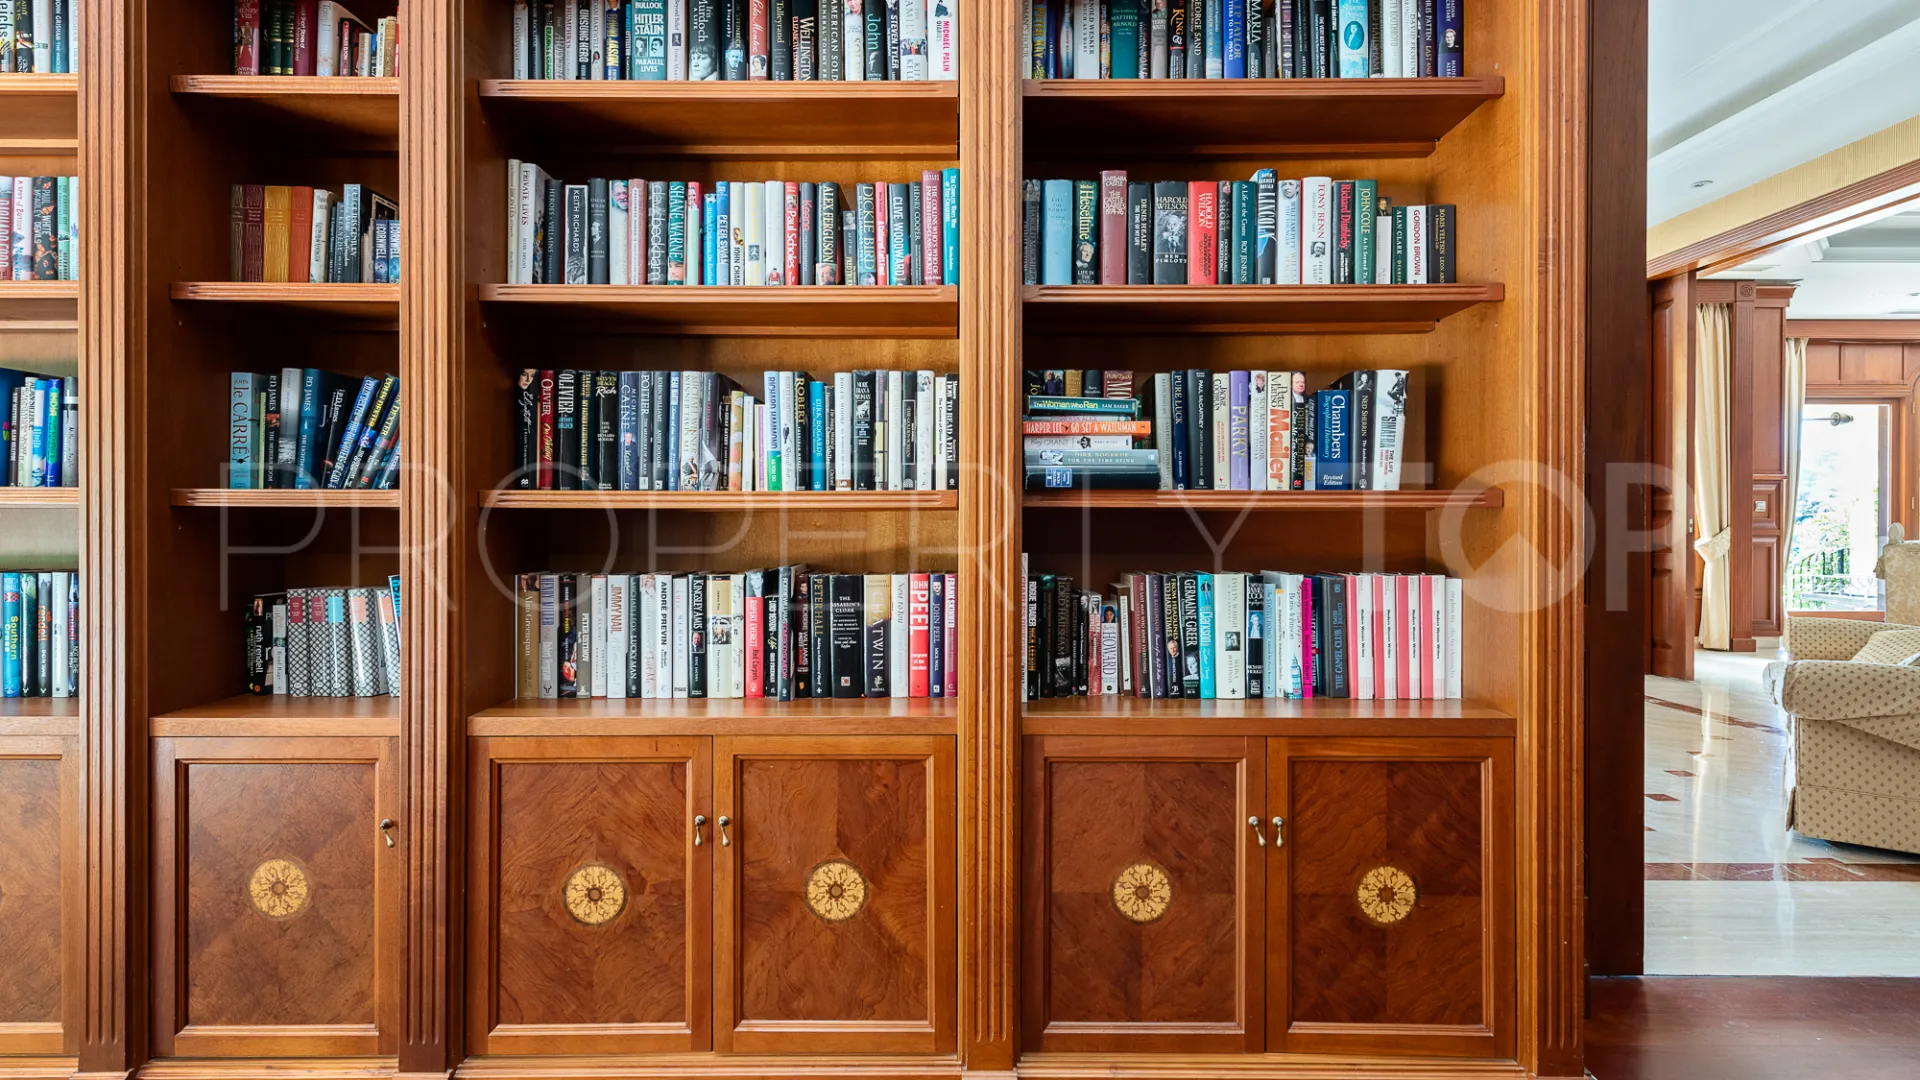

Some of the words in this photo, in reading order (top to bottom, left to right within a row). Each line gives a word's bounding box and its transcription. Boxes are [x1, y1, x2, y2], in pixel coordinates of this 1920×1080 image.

[634, 14, 664, 25] HITLER
[634, 24, 665, 35] STALIN
[775, 1, 784, 43] Talleyrand
[867, 14, 881, 50] John
[1033, 8, 1045, 36] PETER
[1252, 0, 1261, 43] MARIA
[1034, 40, 1045, 58] KAY
[670, 185, 684, 219] SHANE
[823, 186, 833, 210] ALEX
[863, 186, 874, 233] DICKIE
[893, 197, 903, 219] CLIVE
[1341, 184, 1351, 213] Richard
[1359, 188, 1370, 211] JOHN
[42, 215, 51, 235] WHITE
[787, 210, 796, 231] Paul
[1080, 190, 1094, 240] Heseltine
[1361, 212, 1370, 234] COLE
[376, 227, 387, 259] CORNWELL
[668, 222, 683, 258] WARNE
[823, 212, 833, 262] FERGUSON
[1338, 215, 1351, 249] Dimbleby
[787, 233, 796, 268] Scholes
[864, 238, 874, 270] BIRD
[894, 222, 904, 276] WOODWARD
[50, 392, 58, 416] INDIA
[233, 386, 248, 398] le
[558, 374, 574, 414] OLIVIER
[621, 385, 630, 429] CAINE
[796, 378, 805, 424] ROBERT
[947, 400, 952, 411] TO
[1270, 374, 1282, 408] Manso
[1278, 386, 1288, 408] Peter
[232, 402, 250, 455] CARRÉ
[769, 411, 777, 449] HAMMOND
[1026, 422, 1050, 433] HARPER
[1052, 422, 1062, 433] LEE
[1070, 422, 1079, 432] GO
[1082, 422, 1092, 432] SET
[1094, 422, 1098, 432] A
[1100, 422, 1136, 432] WATCHMAN
[1232, 405, 1246, 458] PARKY
[1332, 395, 1345, 458] Chambers
[1380, 416, 1396, 448] SINATRA
[1270, 408, 1289, 483] Mailer
[611, 584, 621, 613] JIMMY
[693, 580, 703, 611] KINGSLEY
[814, 578, 823, 609] PETER
[911, 580, 928, 589] JOHN
[1165, 582, 1171, 591] TO
[1184, 579, 1196, 619] GERMAINE
[38, 605, 47, 641] rendell
[611, 615, 621, 634] NAIL
[693, 613, 703, 629] AMIS
[814, 611, 823, 637] HALL
[910, 590, 928, 635] PEEL
[1200, 611, 1212, 643] Clarkson
[10, 616, 18, 660] Southern
[872, 592, 883, 670] CHATWIN
[1186, 621, 1197, 646] GREER
[1334, 630, 1343, 648] CLUB
[255, 644, 263, 673] rendell
[1102, 632, 1116, 675] HOWARD
